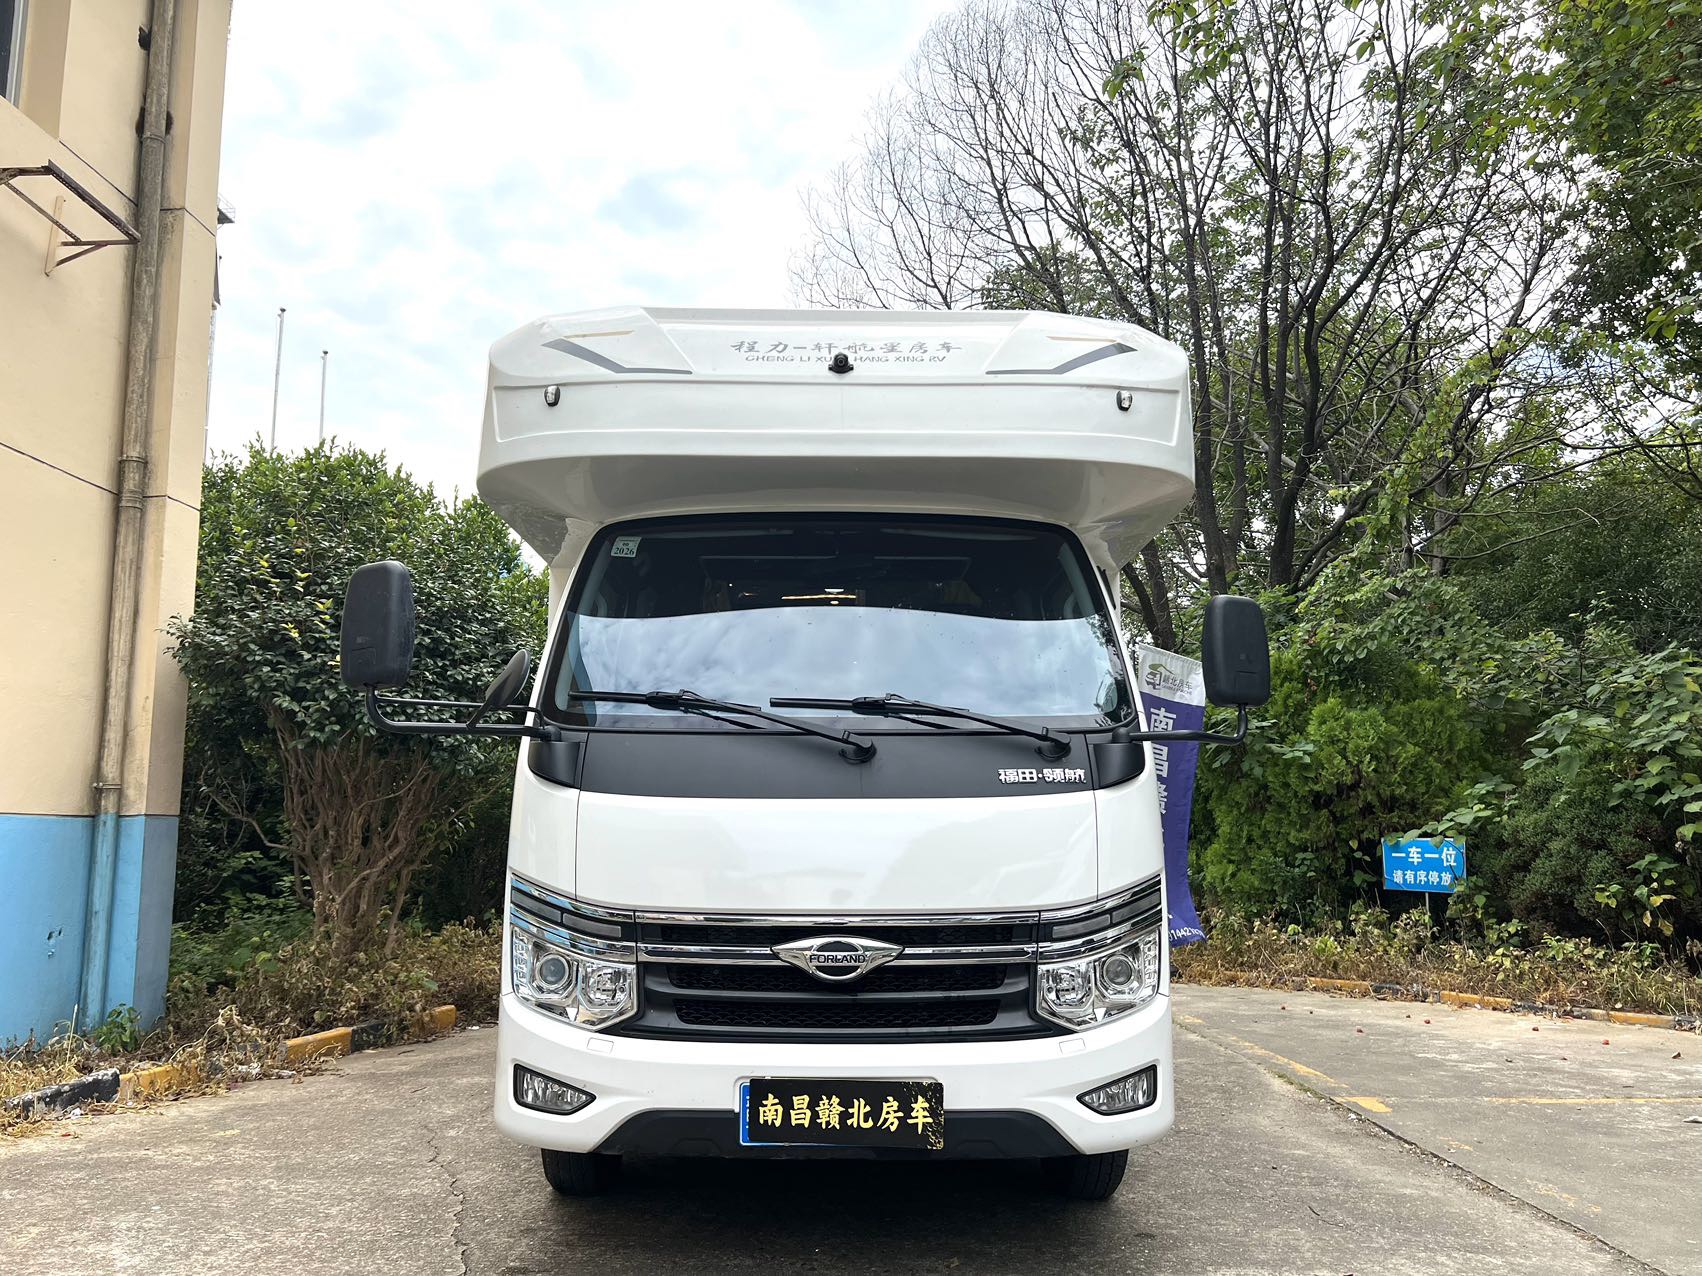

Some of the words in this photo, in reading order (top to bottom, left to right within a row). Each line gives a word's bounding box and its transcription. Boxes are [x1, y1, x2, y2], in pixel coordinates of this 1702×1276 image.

[745, 354, 795, 363] CHENG
[799, 355, 811, 363] LI
[854, 355, 889, 363] HANG
[894, 355, 925, 363] XING
[929, 355, 947, 363] RV
[613, 547, 635, 556] 2026
[1391, 846, 1457, 866] 一车一位
[1393, 870, 1452, 886] 请有序停放
[809, 954, 866, 964] FORLAND
[758, 1093, 934, 1135] 南昌赣北房车
